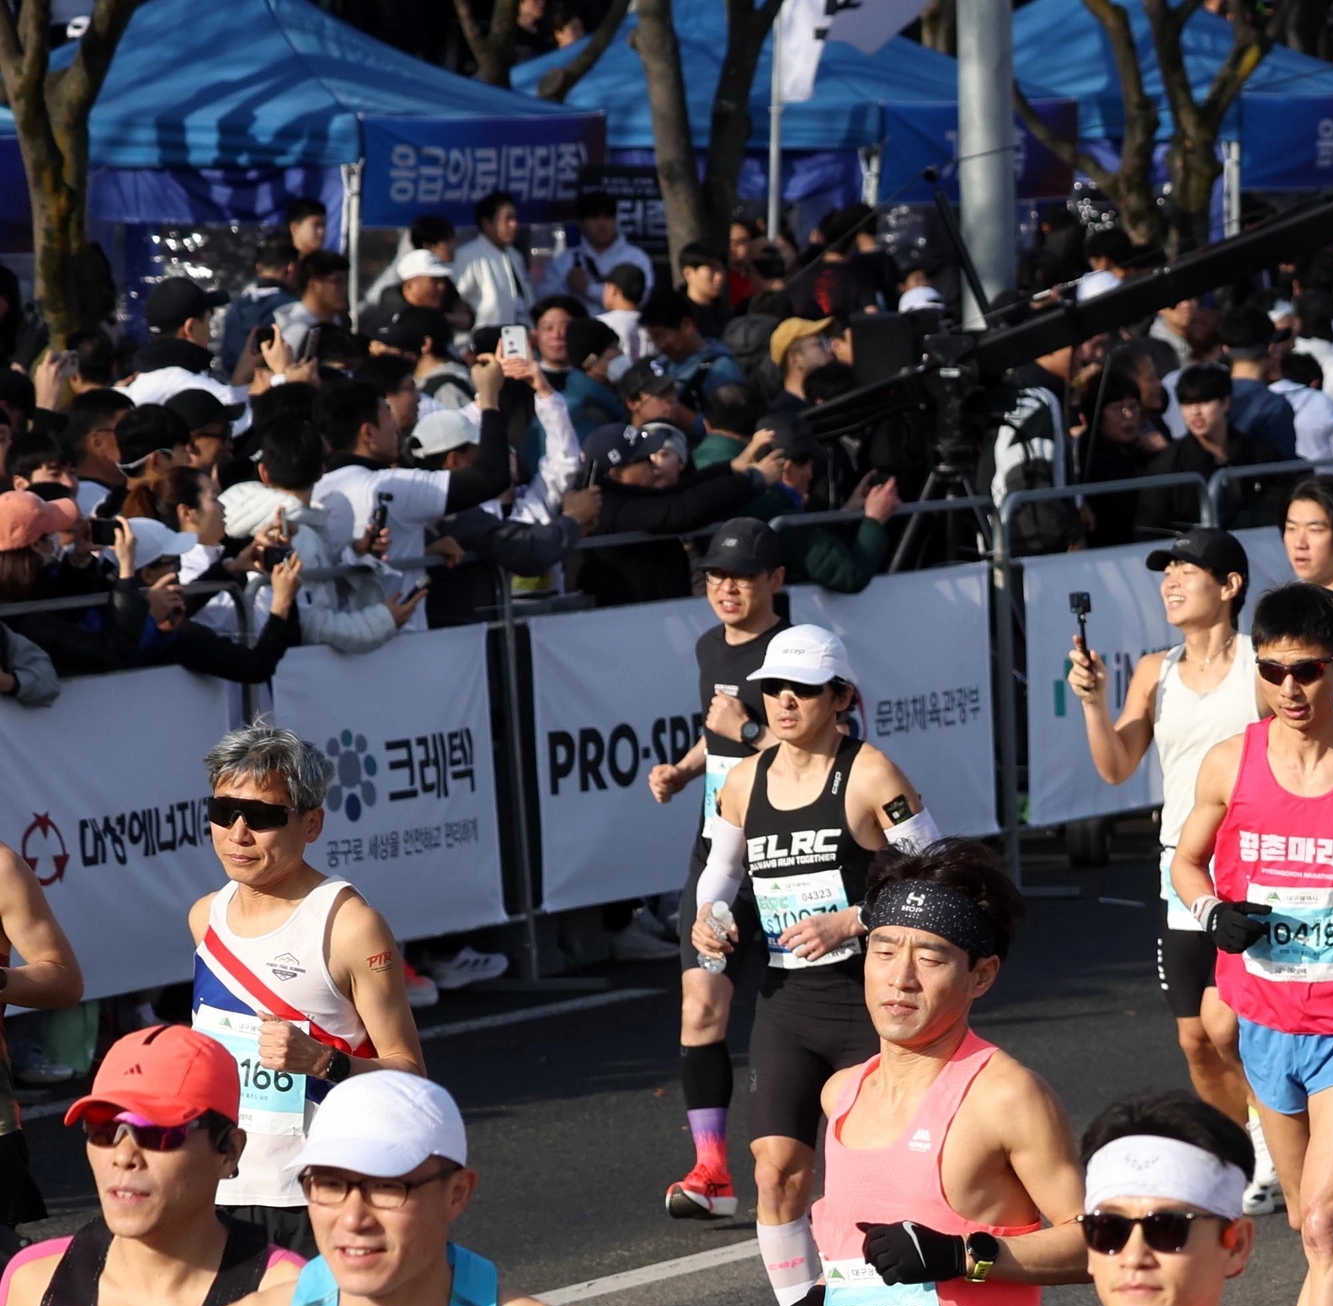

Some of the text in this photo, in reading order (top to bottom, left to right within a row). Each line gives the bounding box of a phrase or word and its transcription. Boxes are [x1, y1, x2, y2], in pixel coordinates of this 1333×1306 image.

[875, 685, 981, 739] 문화체육관광부
[385, 727, 475, 802] 크레텍
[326, 838, 364, 868] 공구로
[746, 828, 843, 863] ELRC
[777, 857, 795, 868] RUN
[795, 853, 837, 866] TOGETHER
[801, 888, 833, 902] 04323
[366, 951, 393, 968] PTR
